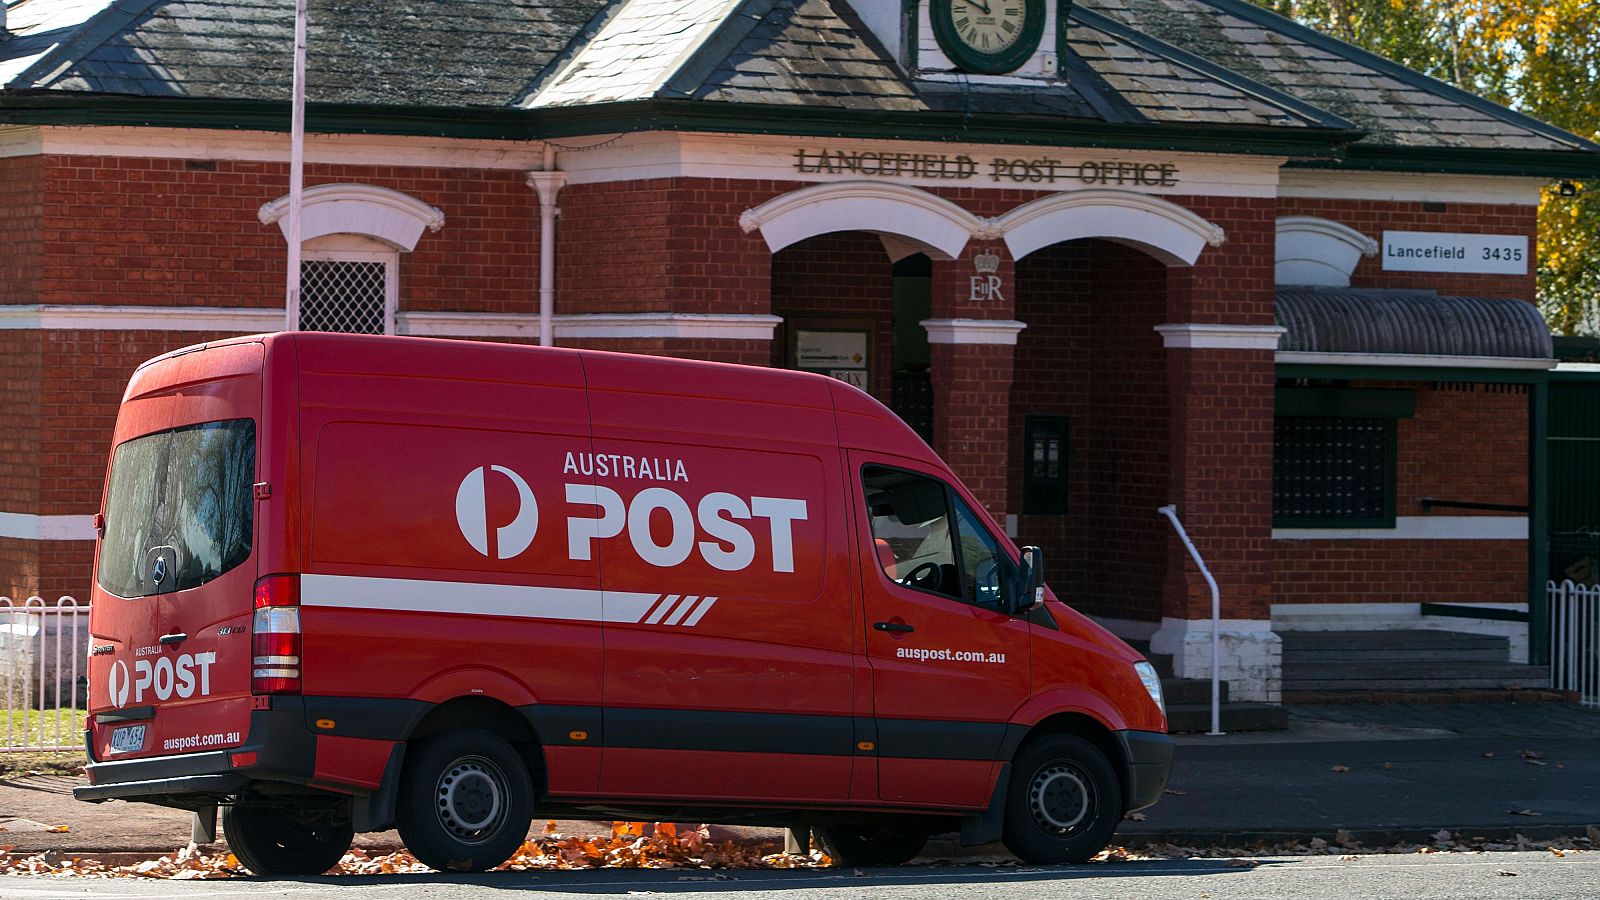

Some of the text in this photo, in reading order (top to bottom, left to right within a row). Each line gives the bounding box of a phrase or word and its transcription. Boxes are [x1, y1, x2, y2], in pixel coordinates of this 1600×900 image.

[798, 149, 1176, 187] LANCEFIELD POST OFFICE
[1388, 244, 1522, 261] Lancefield 3435
[563, 451, 689, 482] AUSTRALIA
[564, 483, 808, 573] POST
[135, 646, 163, 656] AUSTRALIA
[896, 647, 1006, 664] auspost.com.au
[135, 651, 217, 703] POST
[163, 731, 240, 751] auspost.com.au
